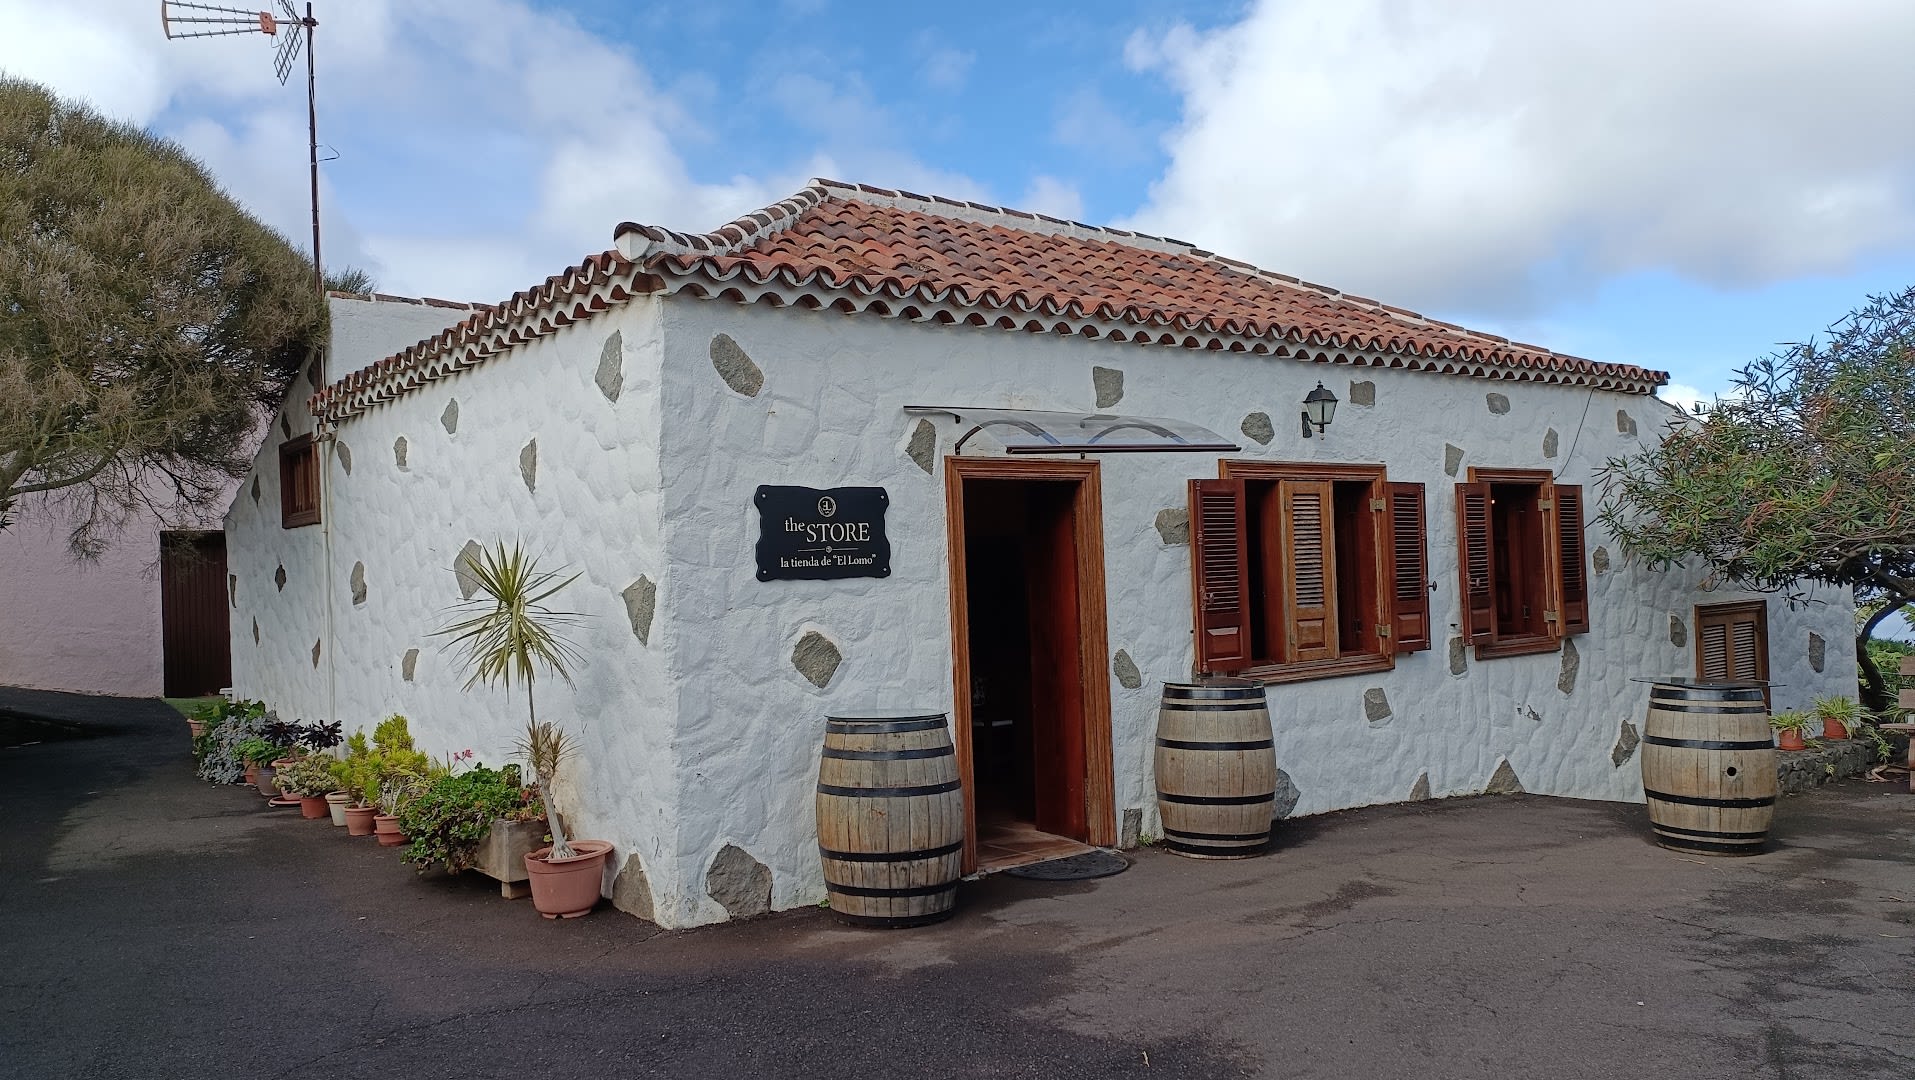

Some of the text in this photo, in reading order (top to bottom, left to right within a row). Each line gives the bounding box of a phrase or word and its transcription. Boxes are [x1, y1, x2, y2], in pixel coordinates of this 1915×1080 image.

[785, 517, 870, 542] the STORE
[780, 557, 789, 567] la
[791, 556, 819, 567] tienda
[821, 556, 831, 566] de
